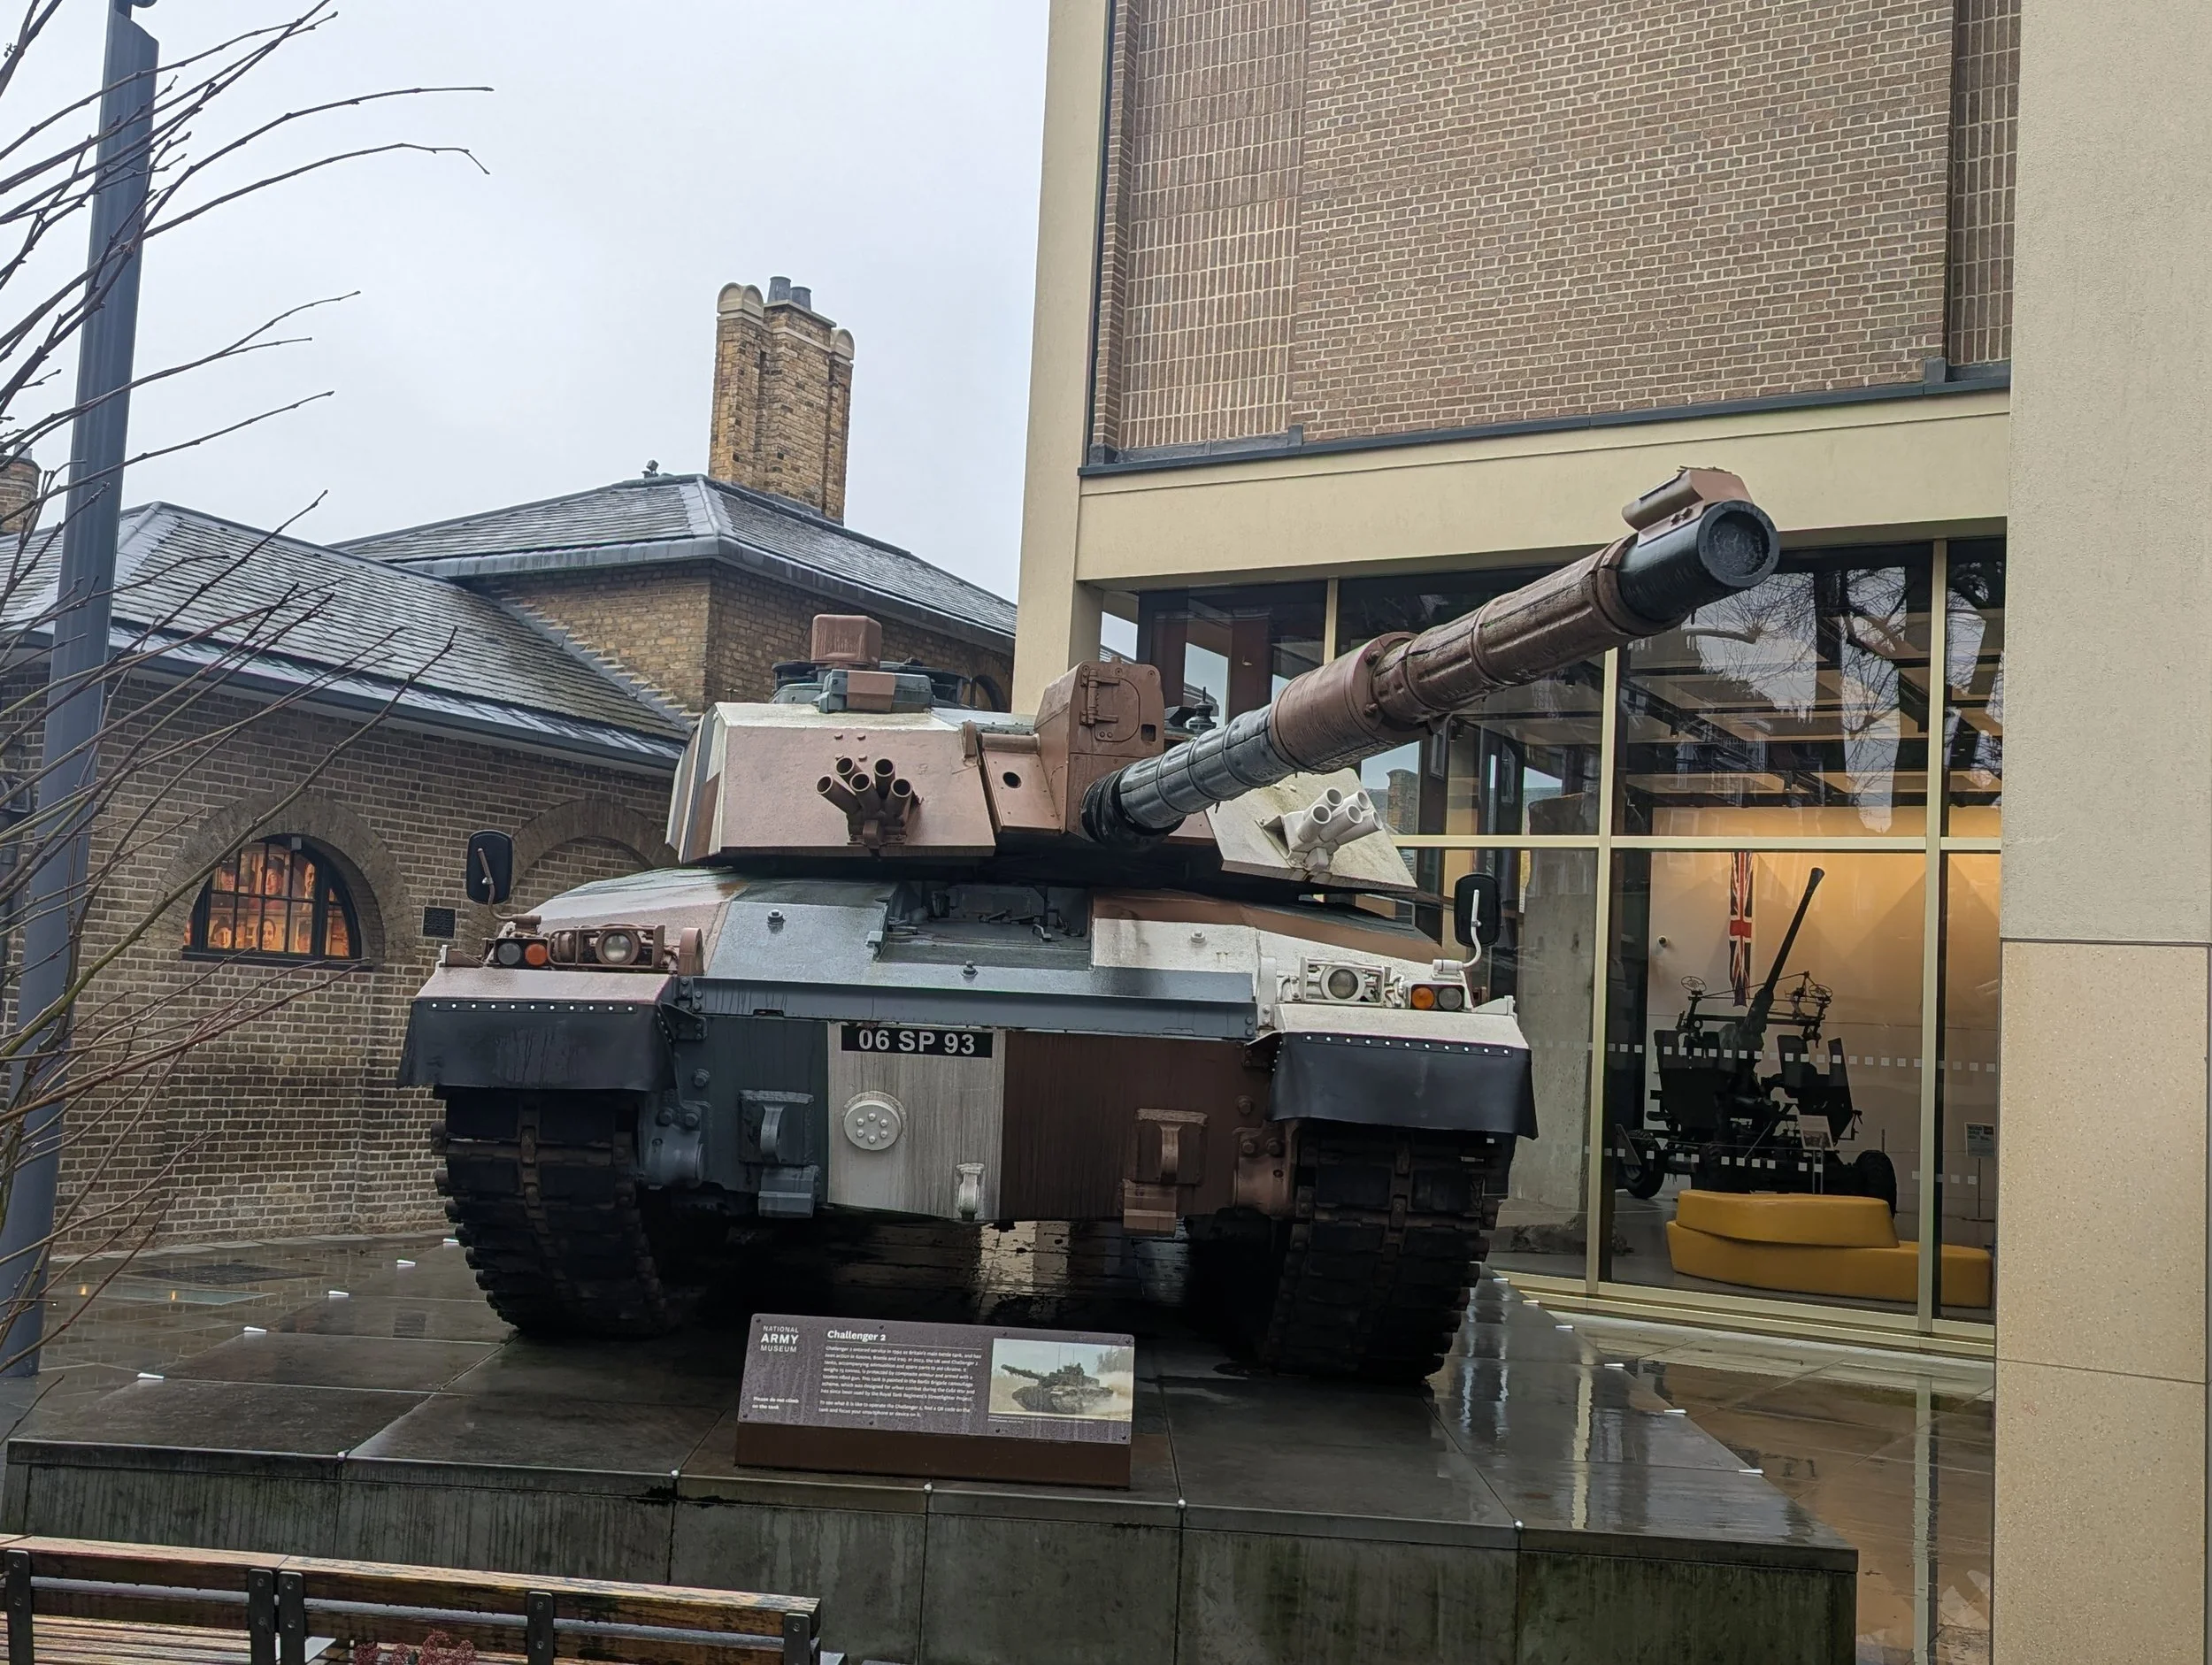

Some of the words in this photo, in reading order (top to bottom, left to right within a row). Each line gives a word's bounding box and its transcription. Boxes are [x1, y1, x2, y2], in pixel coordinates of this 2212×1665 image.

[858, 1029, 890, 1050] 06
[898, 1030, 935, 1052] SP
[944, 1032, 975, 1055] 93
[761, 1333, 799, 1345] ARMY
[827, 1330, 879, 1342] Challenger
